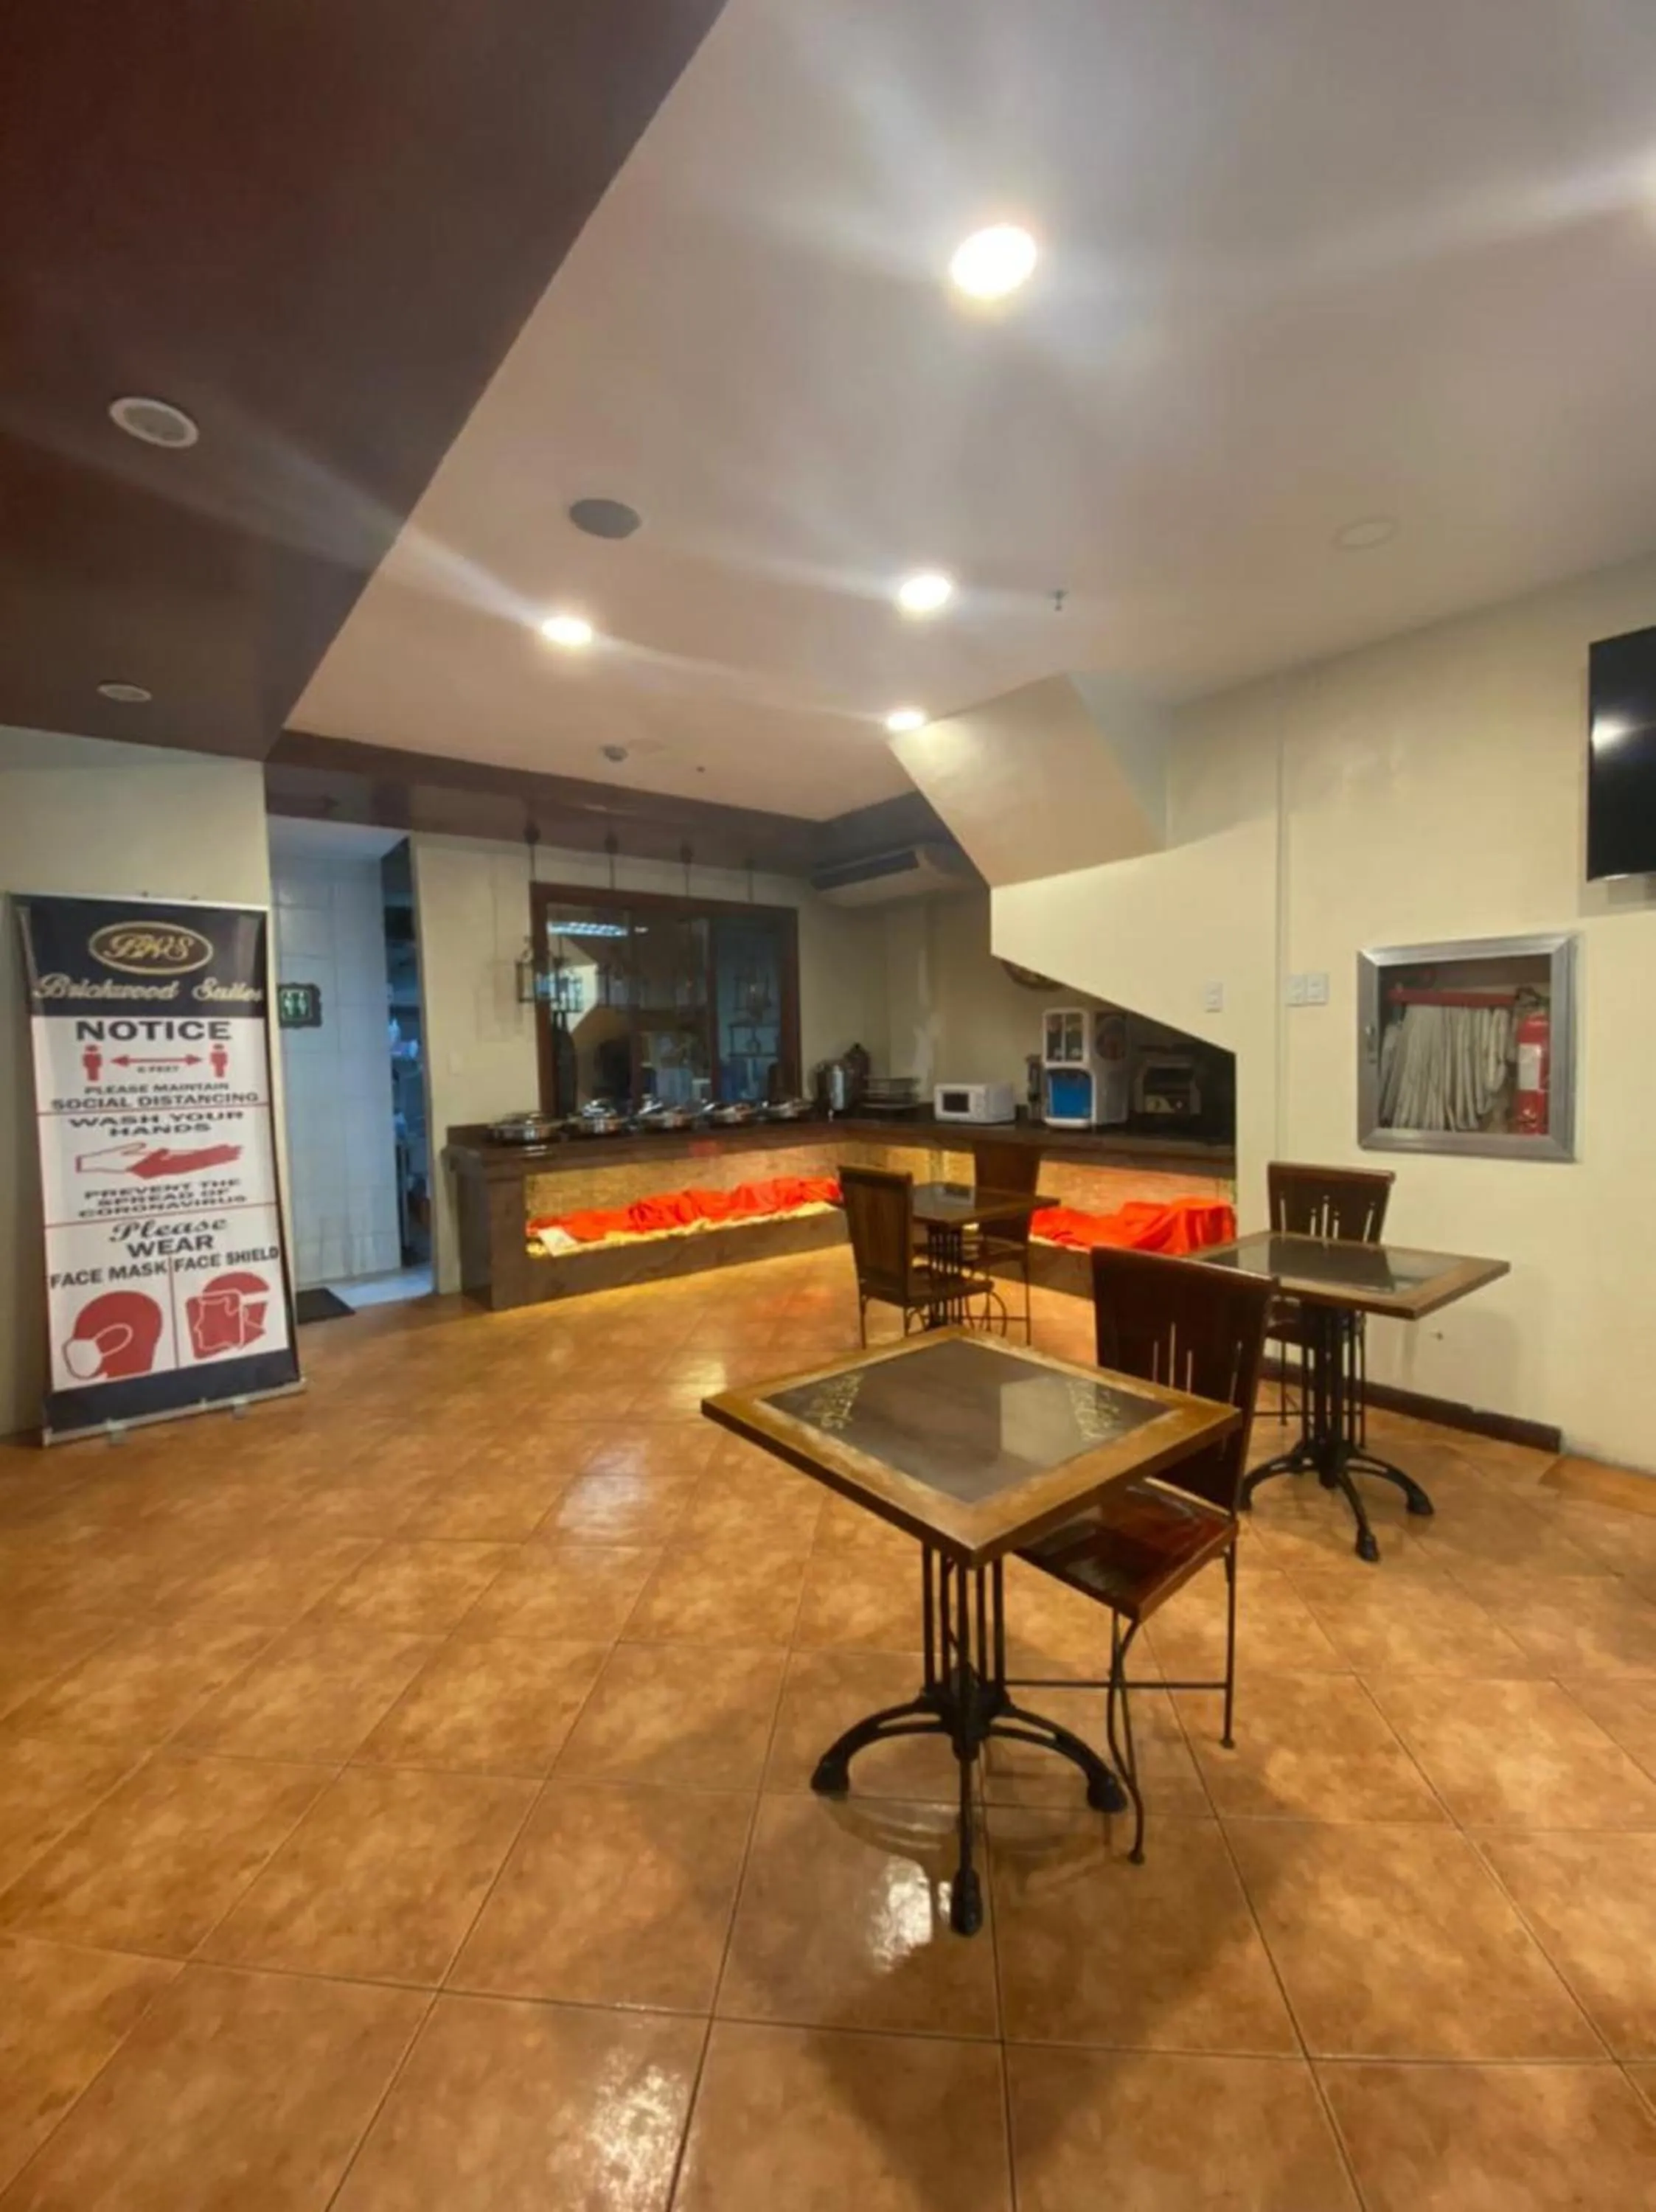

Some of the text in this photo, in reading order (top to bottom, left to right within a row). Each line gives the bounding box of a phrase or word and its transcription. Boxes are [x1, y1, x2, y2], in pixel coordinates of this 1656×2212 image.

[76, 1020, 232, 1041] NOTICE
[85, 1082, 230, 1095] PLEASE MAINTAIN
[52, 1092, 259, 1110] SOCIAL DISTANCING
[69, 1111, 245, 1127] WASH YOUR
[108, 1123, 212, 1136] HANDS
[85, 1178, 241, 1200] PREVENT THE
[98, 1187, 230, 1206] SPREAD OF
[78, 1195, 247, 1218] CORONAVIRUS
[109, 1219, 229, 1242] Please
[127, 1234, 214, 1258] WEAR
[174, 1246, 280, 1273] FACE SHIELD
[50, 1261, 167, 1289] FACE MASK
